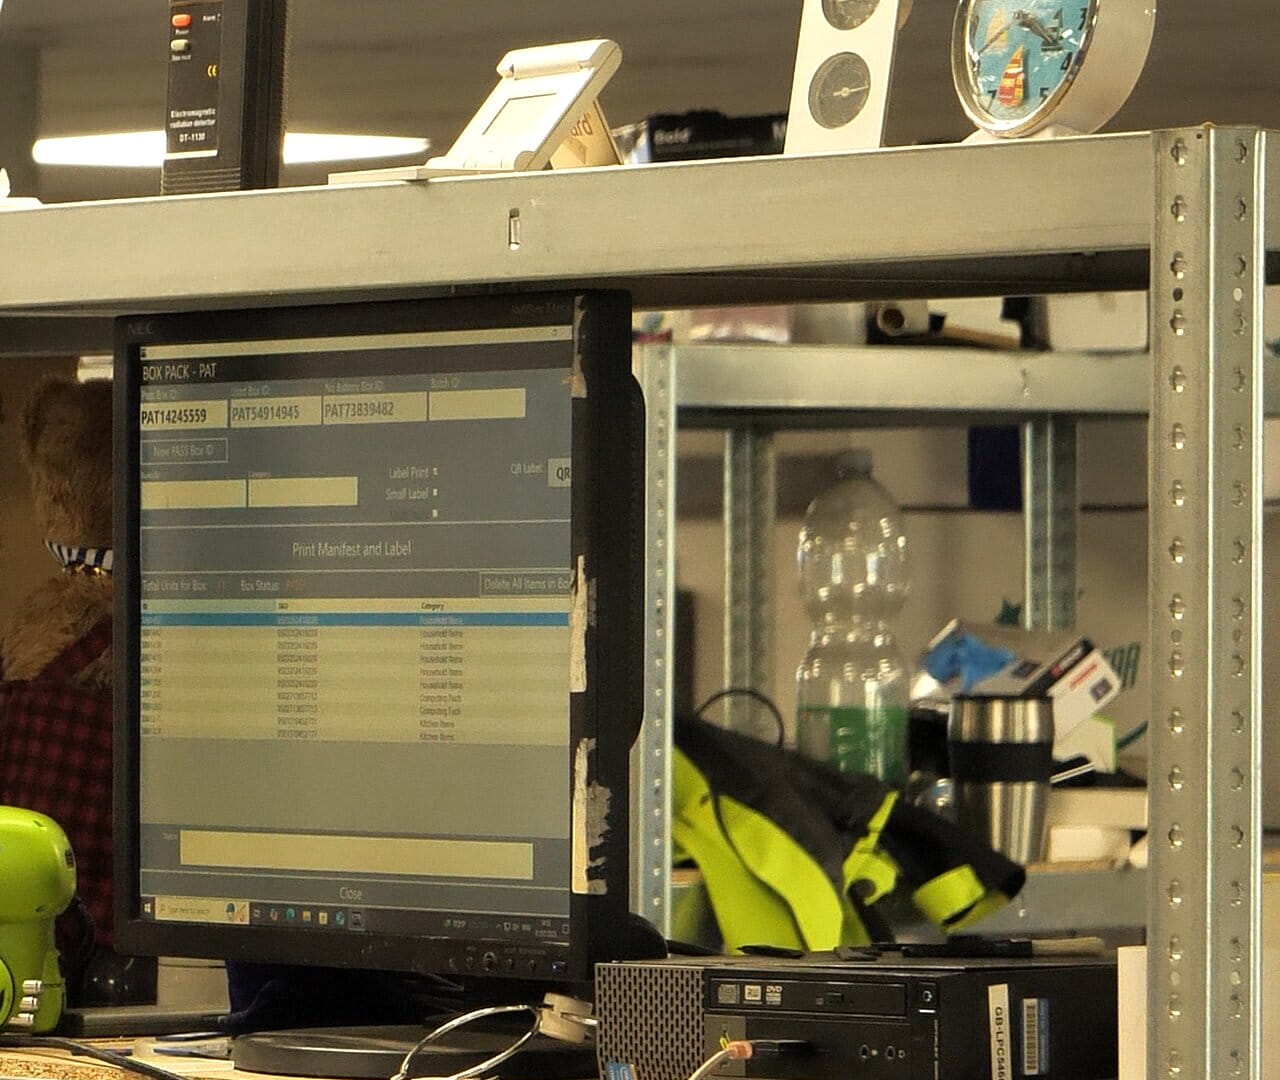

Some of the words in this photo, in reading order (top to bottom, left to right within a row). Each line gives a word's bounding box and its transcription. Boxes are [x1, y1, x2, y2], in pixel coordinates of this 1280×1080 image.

[170, 108, 216, 118] Electromagnetic
[170, 121, 192, 129] radiation
[193, 119, 216, 127] detector
[142, 366, 161, 381] BOX
[164, 364, 190, 380] PACK
[199, 363, 217, 378] PAT
[141, 408, 207, 424] PAT14245559
[232, 405, 300, 421] PAT54914945
[324, 401, 394, 418] PAT73839482
[171, 446, 189, 457] PASS
[388, 466, 409, 479] Label
[410, 466, 429, 479] Print
[385, 488, 407, 500] Small
[408, 487, 429, 500] Label
[292, 543, 315, 558] Print
[318, 542, 360, 558] Manifest
[362, 541, 382, 557] and
[384, 540, 412, 556] Label
[142, 579, 160, 592] Total
[240, 579, 254, 592] Box
[484, 577, 511, 590] Delete
[524, 577, 546, 590] Items
[339, 886, 362, 900] Close
